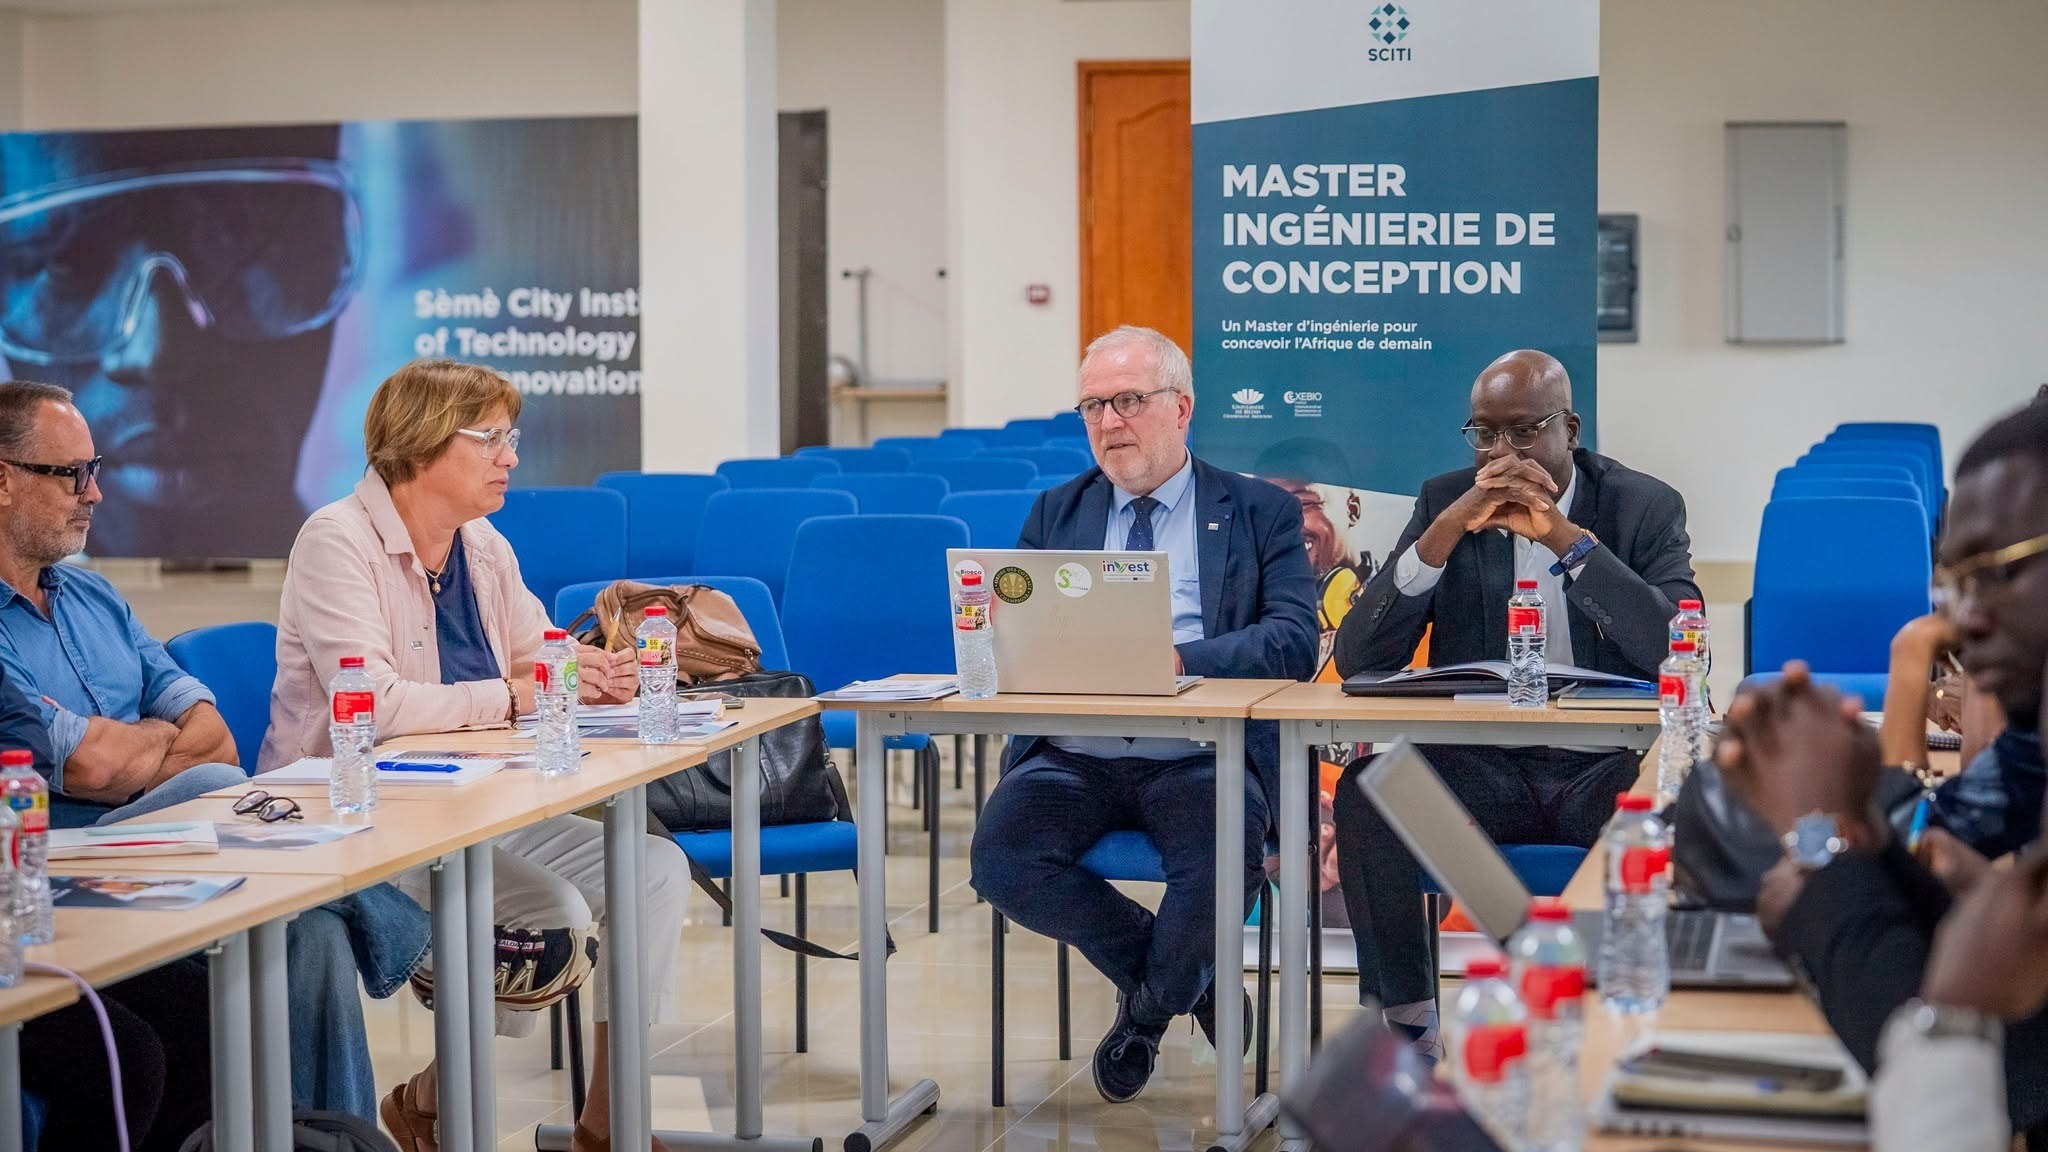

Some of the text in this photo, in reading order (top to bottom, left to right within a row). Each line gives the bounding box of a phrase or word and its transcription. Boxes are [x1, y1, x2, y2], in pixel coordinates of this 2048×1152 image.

[1368, 48, 1412, 62] SCITI
[1222, 163, 1407, 198] MASTER
[1222, 204, 1556, 247] INGÉNIERIE DE
[1222, 260, 1522, 295] CONCEPTION
[414, 286, 640, 323] Sèmè City Inst
[414, 325, 637, 361] of Technology
[1221, 320, 1418, 336] Un Master d'ingénierie pour
[1221, 337, 1432, 352] concevoir l'Afrique de demain
[496, 364, 641, 396] novation
